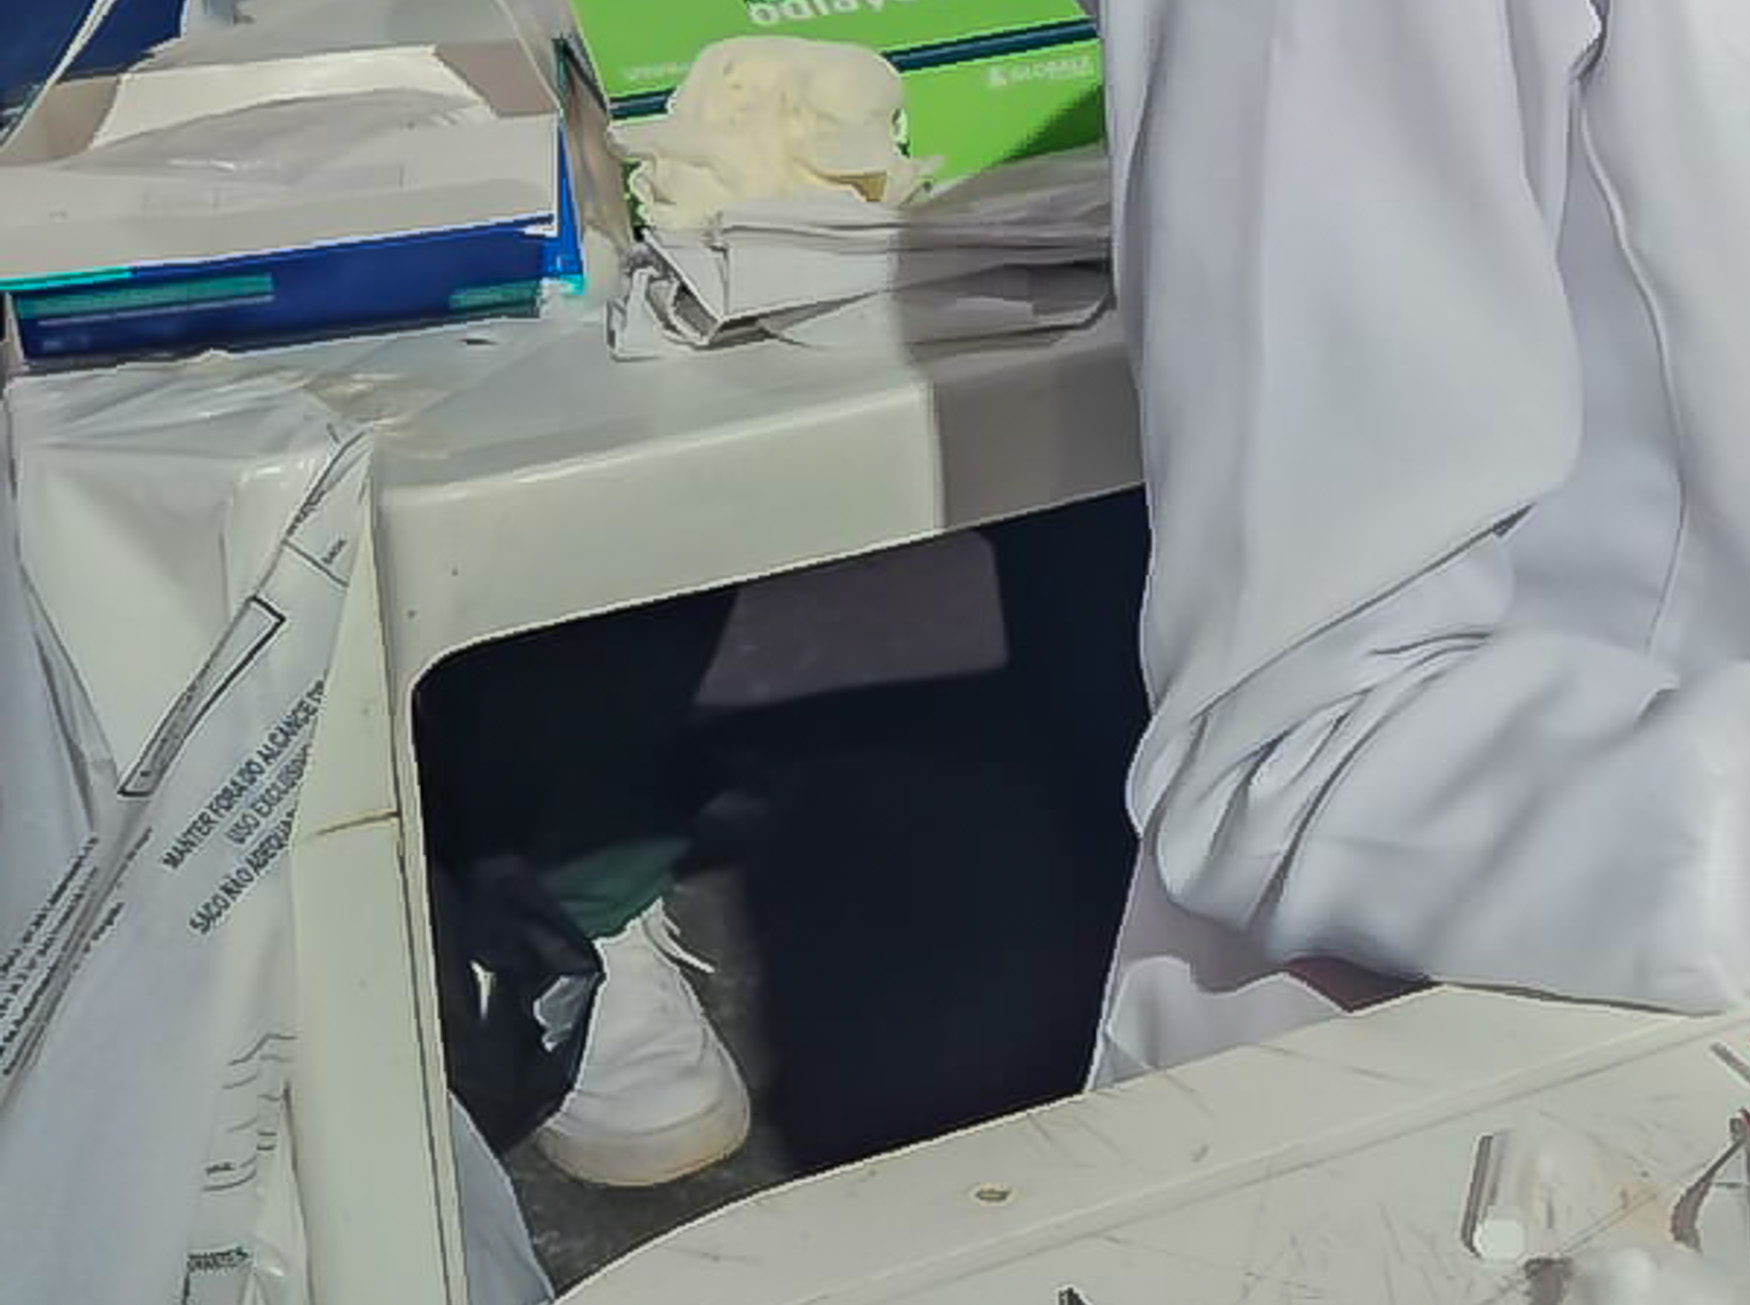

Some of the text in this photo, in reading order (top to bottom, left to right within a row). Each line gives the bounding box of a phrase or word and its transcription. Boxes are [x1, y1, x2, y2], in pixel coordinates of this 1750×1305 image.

[161, 811, 215, 870] MANTER
[207, 779, 247, 818] FORA
[237, 759, 265, 786] DO
[256, 700, 316, 765] ALCANCE
[226, 811, 260, 845] USO
[189, 893, 230, 935] SACO
